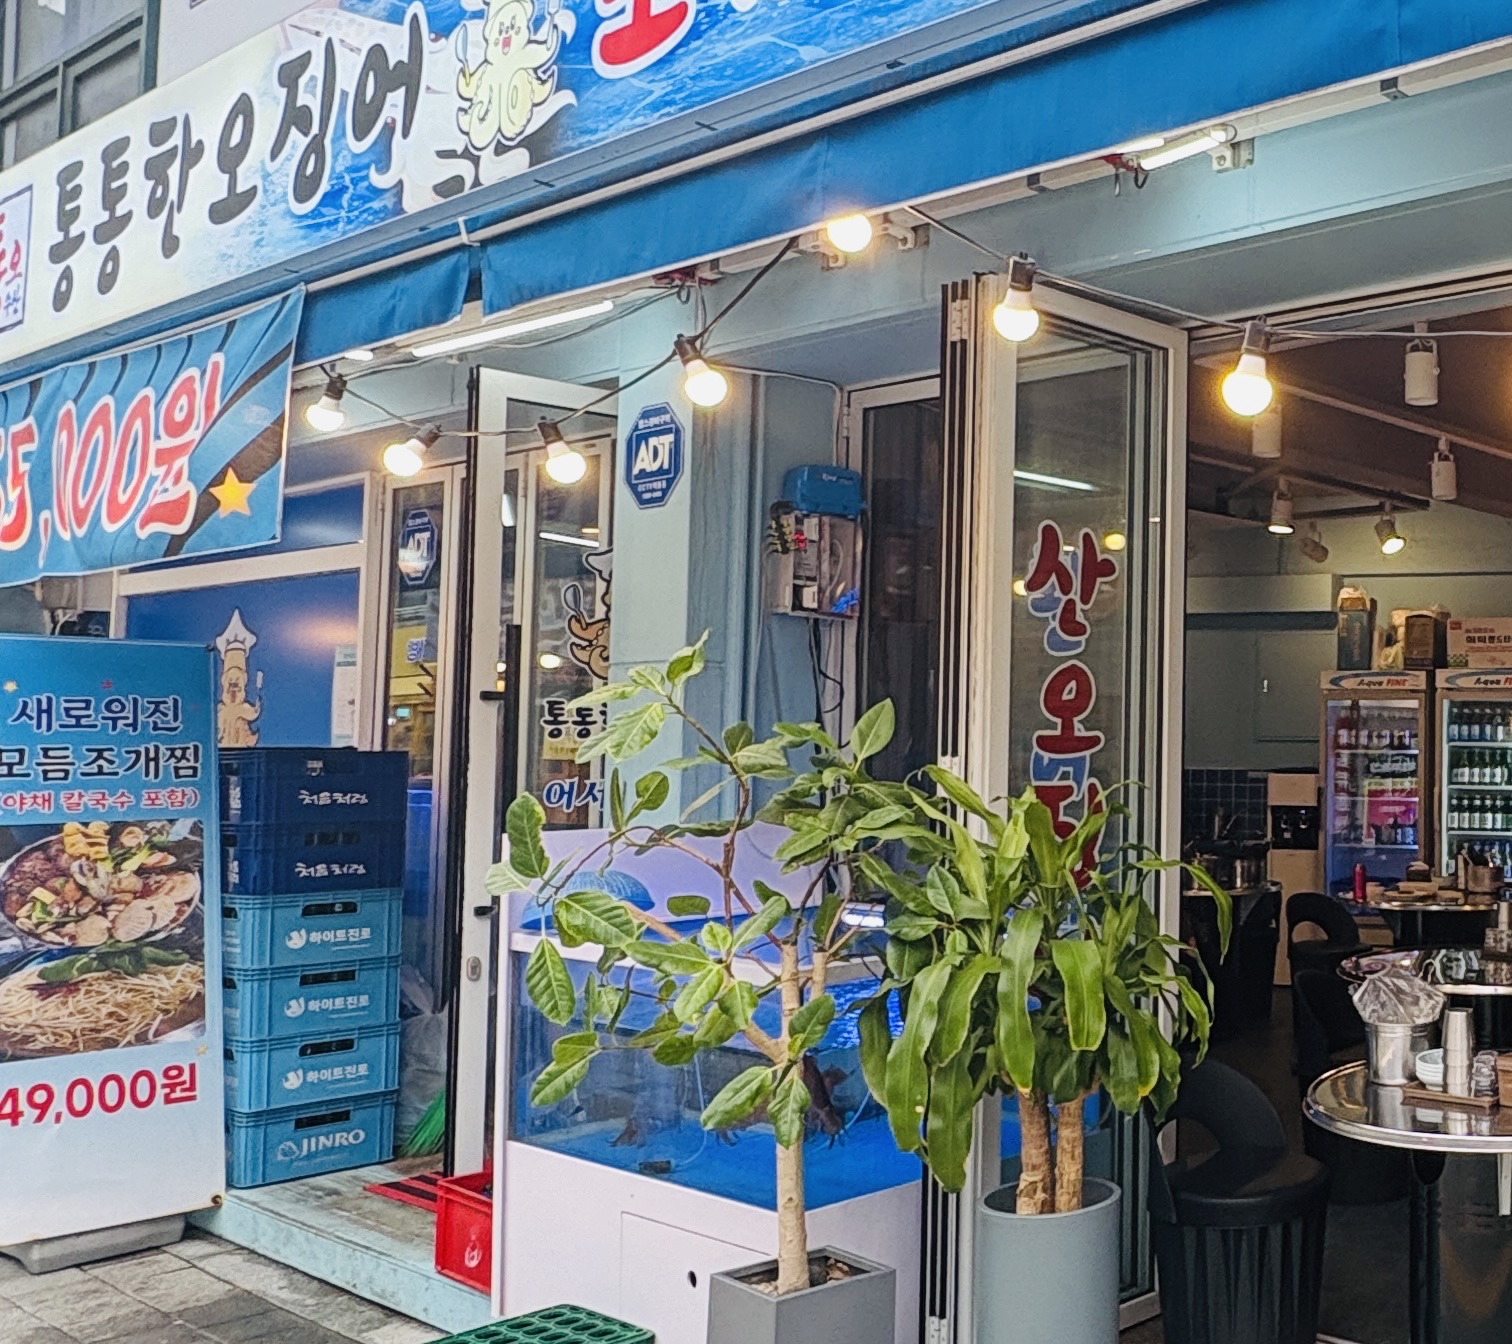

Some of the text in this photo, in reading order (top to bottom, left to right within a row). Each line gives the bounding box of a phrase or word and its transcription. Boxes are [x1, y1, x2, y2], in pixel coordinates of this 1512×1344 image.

[49, 13, 423, 313] 통통한오징어
[0, 358, 222, 568] 5,000원
[633, 433, 675, 476] ADT
[11, 696, 182, 733] 새로워진
[0, 744, 201, 781] 모듬조개찜
[0, 789, 199, 812] 야채 칼국수 포함)
[298, 789, 369, 806] 처음처럼
[294, 862, 367, 878] 처음처럼
[309, 927, 371, 944] 하이트진로
[308, 994, 370, 1012] 하이트진로
[306, 1063, 369, 1083] 하이트진로
[0, 1063, 198, 1127] 49,000원
[301, 1128, 366, 1159] JINRO
